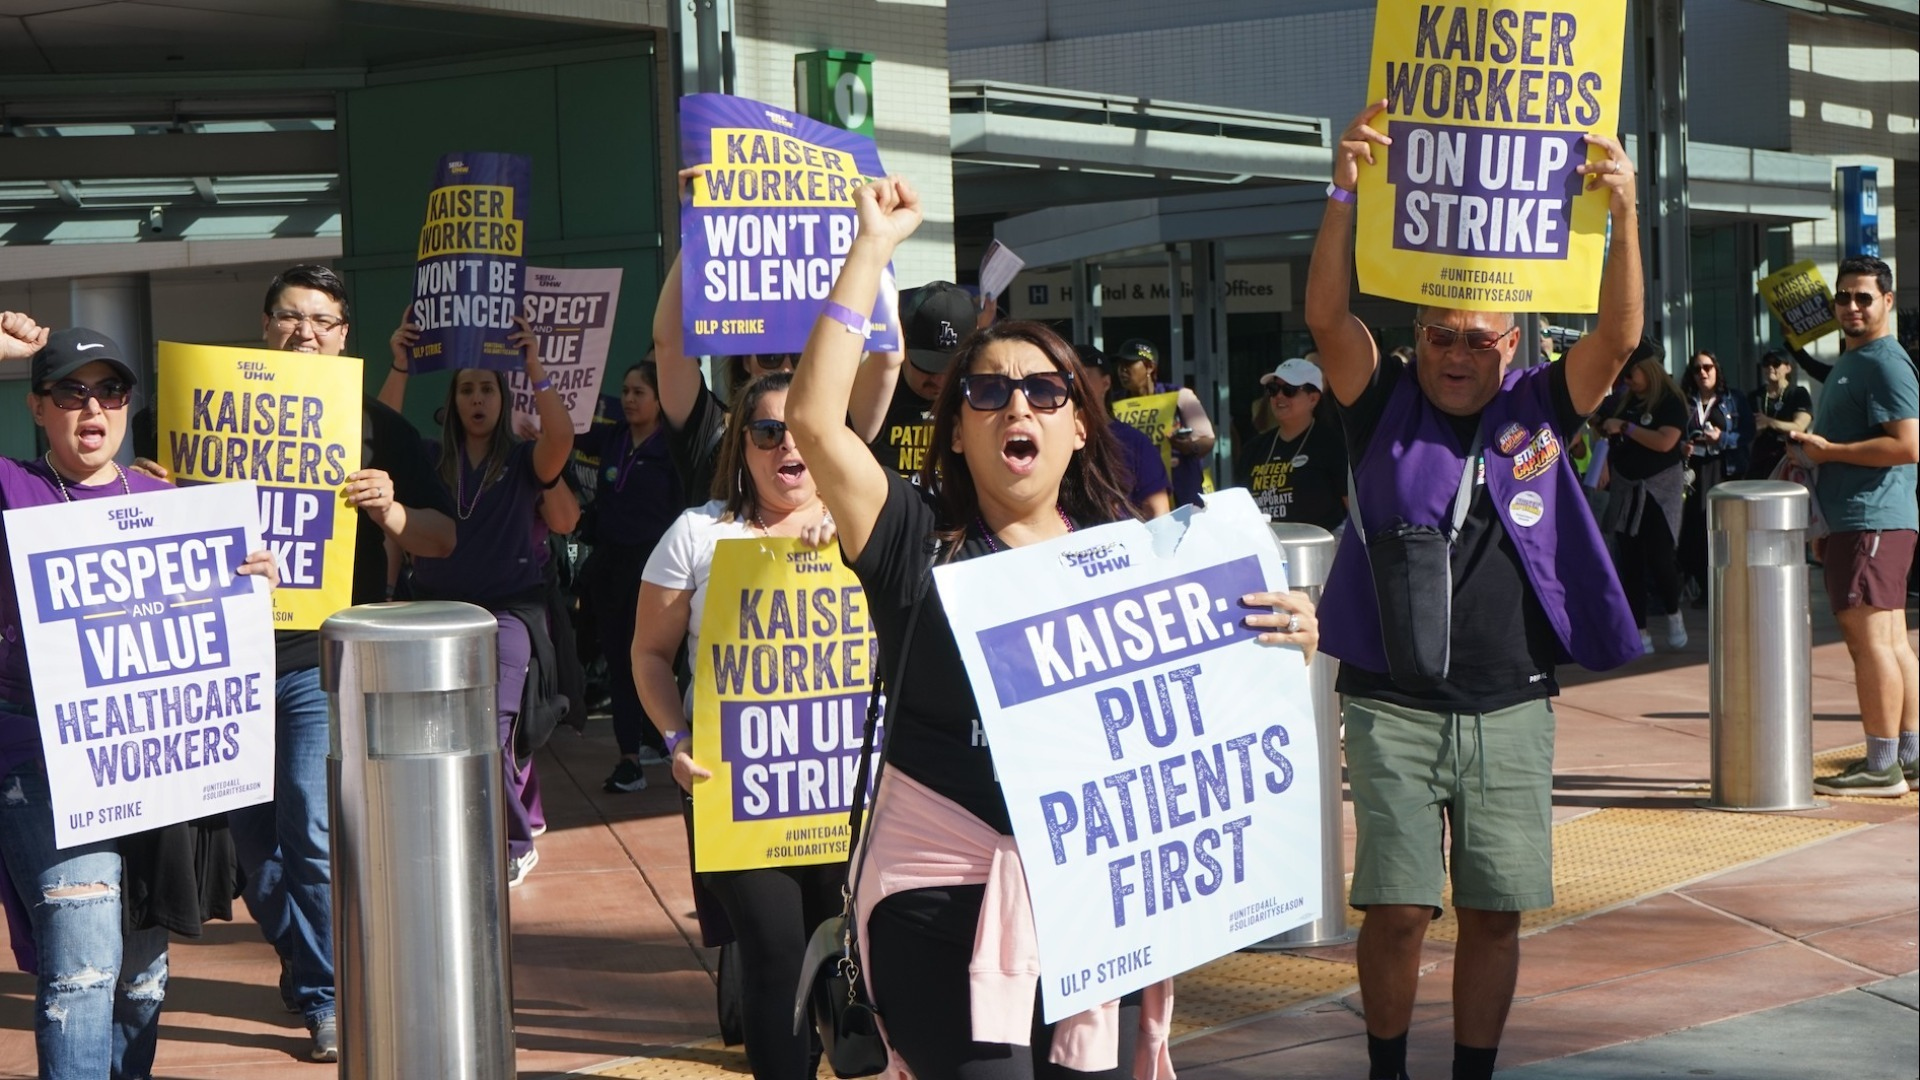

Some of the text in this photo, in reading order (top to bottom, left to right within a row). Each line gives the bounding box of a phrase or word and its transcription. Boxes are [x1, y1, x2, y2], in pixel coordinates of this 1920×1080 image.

[1415, 5, 1577, 66] KAISER
[846, 84, 854, 116] 1
[1386, 61, 1602, 126] WORKERS
[727, 134, 844, 172] KAISER
[1406, 128, 1568, 191] ON ULP
[430, 189, 504, 222] KAISER
[1403, 189, 1563, 253] STRIKE
[422, 221, 517, 255] WORKERS
[703, 214, 859, 257] WON'T B
[417, 260, 516, 297] WON'T BE
[704, 258, 847, 303] SILENC
[1440, 267, 1514, 285] #UNITED4ALL
[1772, 272, 1812, 298] KAISER
[1061, 284, 1126, 302] Hital
[1132, 285, 1145, 299] &
[1421, 282, 1533, 302] #SOLIDARITYSEASON
[1772, 280, 1824, 311] WORKERS
[414, 294, 515, 332] SILENCED
[522, 294, 602, 325] SPECT
[1786, 295, 1822, 323] ON ULP
[1793, 308, 1833, 334] STRIKE
[532, 325, 552, 333] AND
[694, 319, 765, 335] ULP STRIKE
[537, 335, 579, 364] LUE
[237, 361, 267, 371] SEIU-
[243, 371, 275, 381] UHW
[192, 388, 324, 439] KAISER
[1113, 408, 1159, 424] AISER
[890, 425, 935, 447] PATI
[169, 430, 346, 486] WORKERS
[899, 448, 927, 471] NE
[1251, 462, 1294, 477] PATIENT
[1514, 441, 1558, 478] CAPTAIN
[1253, 474, 1286, 490] NEED
[108, 507, 143, 521] SEIU-
[1254, 492, 1293, 507] RPORATE
[1261, 505, 1287, 518] REED
[118, 517, 154, 530] UHW
[786, 551, 823, 563] SEIU-
[795, 562, 833, 574] UHW
[1082, 554, 1130, 578] UHW
[45, 535, 233, 611] RESPECT
[132, 601, 165, 618] AND
[739, 586, 877, 640] KAISE
[85, 611, 222, 680] VALUE
[1024, 582, 1234, 688] KAISER:
[712, 637, 879, 696] WORKE
[54, 672, 261, 744] HEALTHCARE
[1094, 663, 1205, 761] PUT
[740, 704, 799, 759] ON
[86, 721, 240, 788] WORKERS
[203, 778, 240, 793] #UNITED4ALL
[203, 782, 261, 801] #SOLIDARITYSEASON
[742, 752, 881, 816] STRIK
[1038, 724, 1294, 866] PATIENTS
[70, 801, 143, 830] ULP STRIKE
[785, 824, 850, 842] #UNITED4AL
[766, 840, 848, 859] #SOLIDARITYSE
[1108, 815, 1252, 929] FIRST
[1229, 896, 1277, 922] #UNITED4ALL
[1229, 896, 1304, 932] #SOLIDARITYSEASON
[1060, 946, 1153, 998] ULP STRIKE
